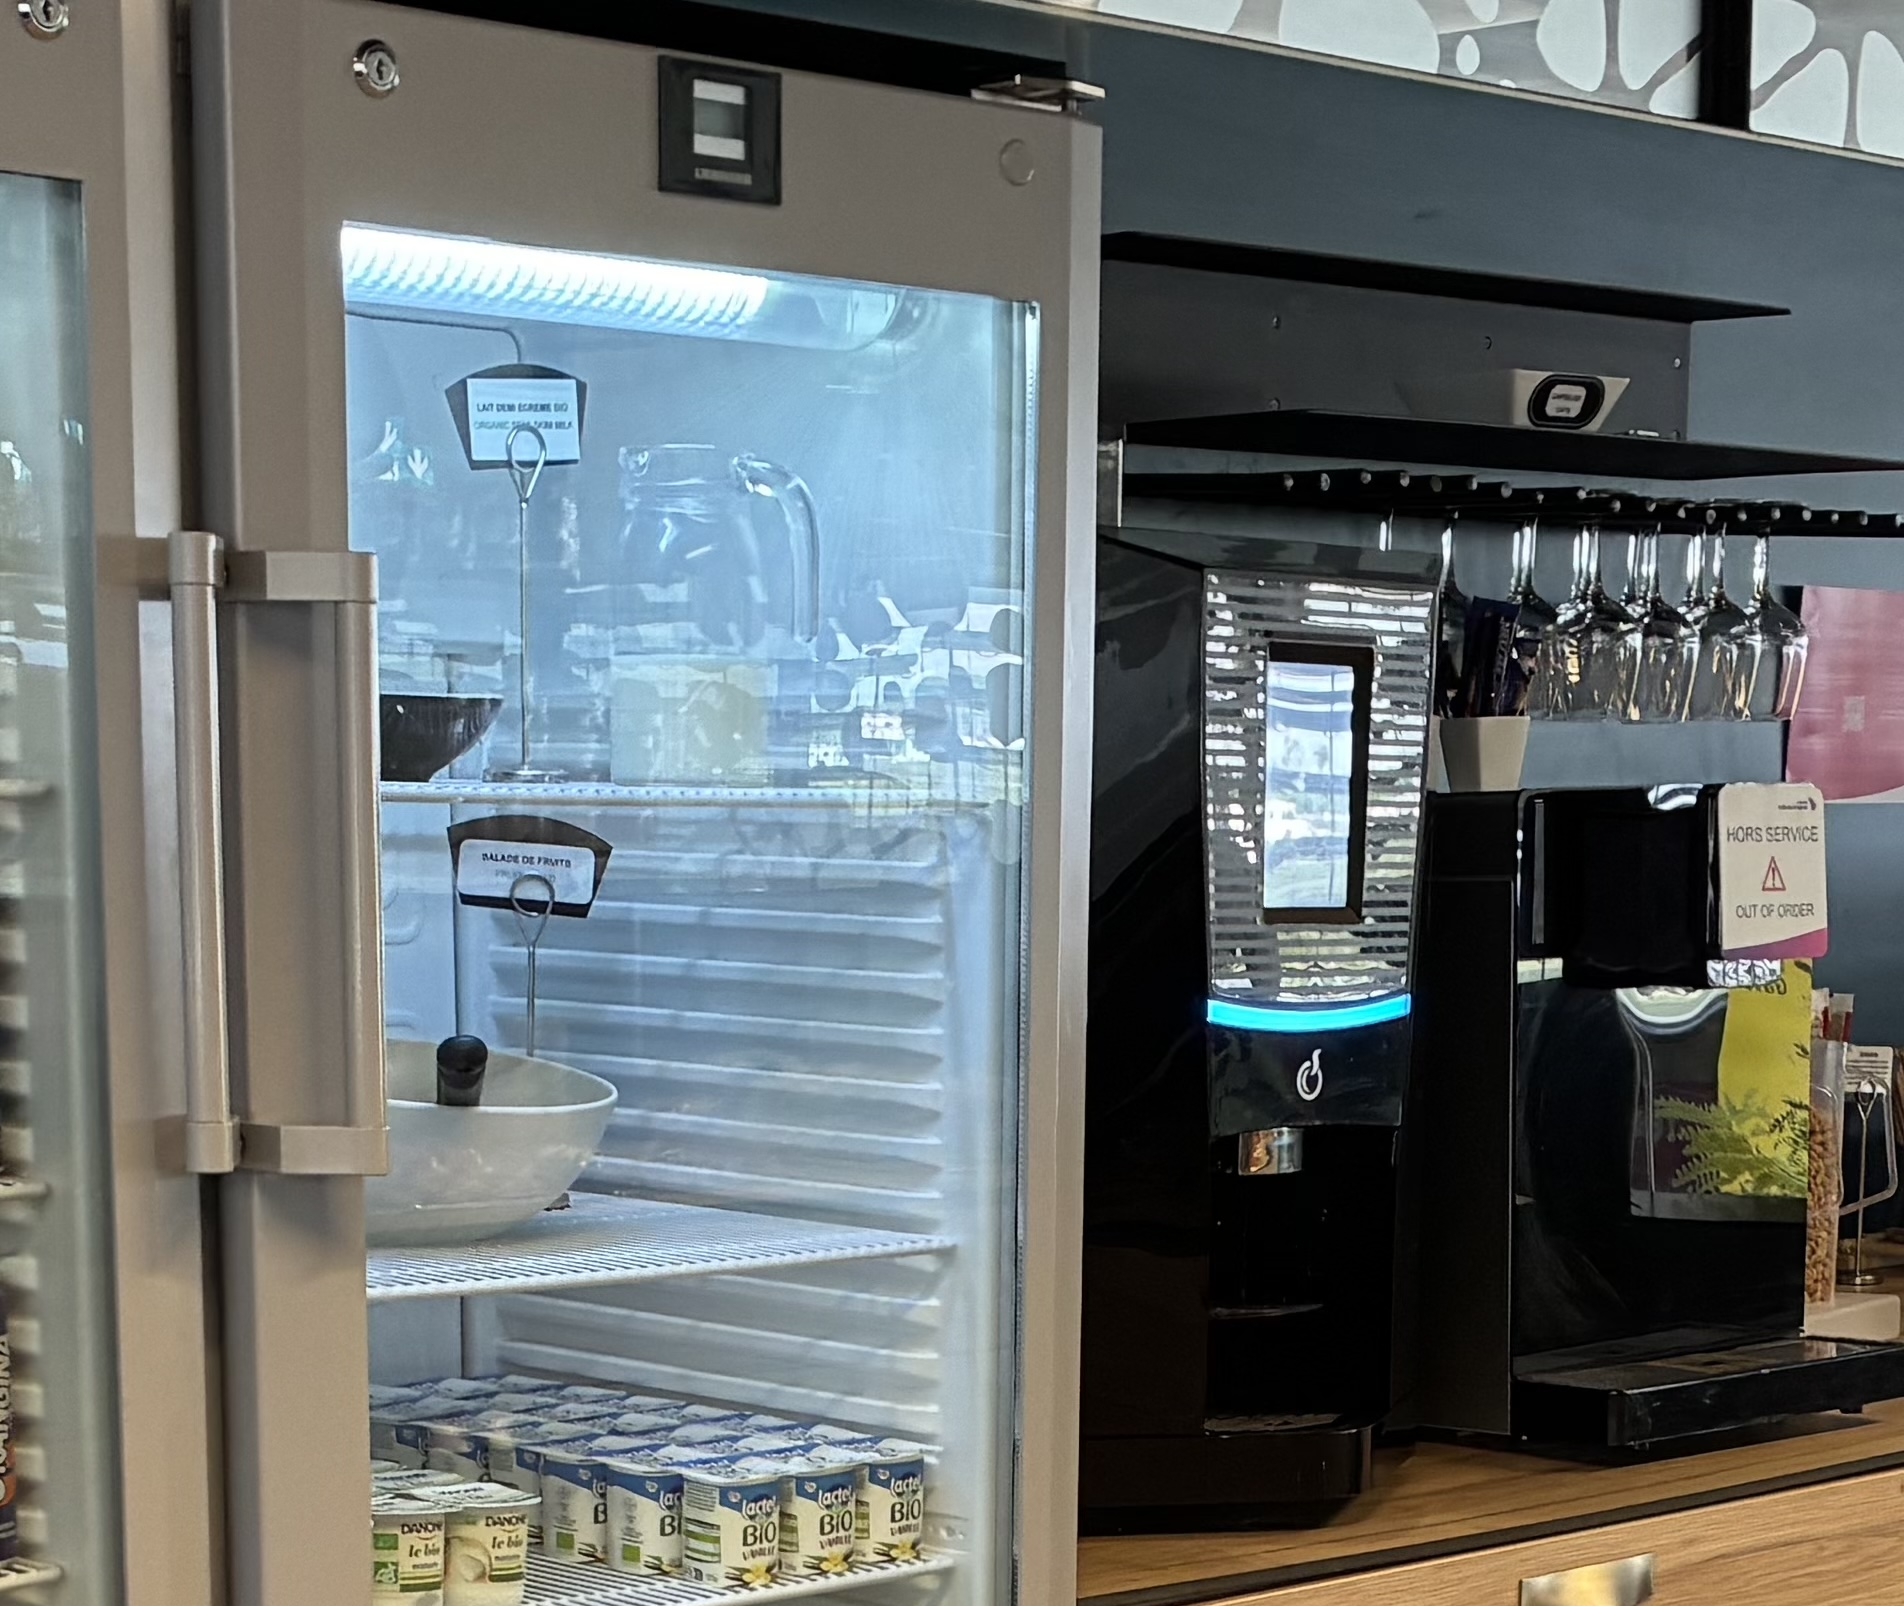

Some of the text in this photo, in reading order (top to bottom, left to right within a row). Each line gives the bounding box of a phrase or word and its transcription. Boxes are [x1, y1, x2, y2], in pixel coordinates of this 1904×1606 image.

[1726, 825, 1819, 843] HORS SERVICE
[1735, 902, 1815, 919] OUT OF ORDER
[819, 1510, 853, 1536] BIO
[890, 1498, 923, 1524] BIO
[742, 1521, 777, 1547] BIO
